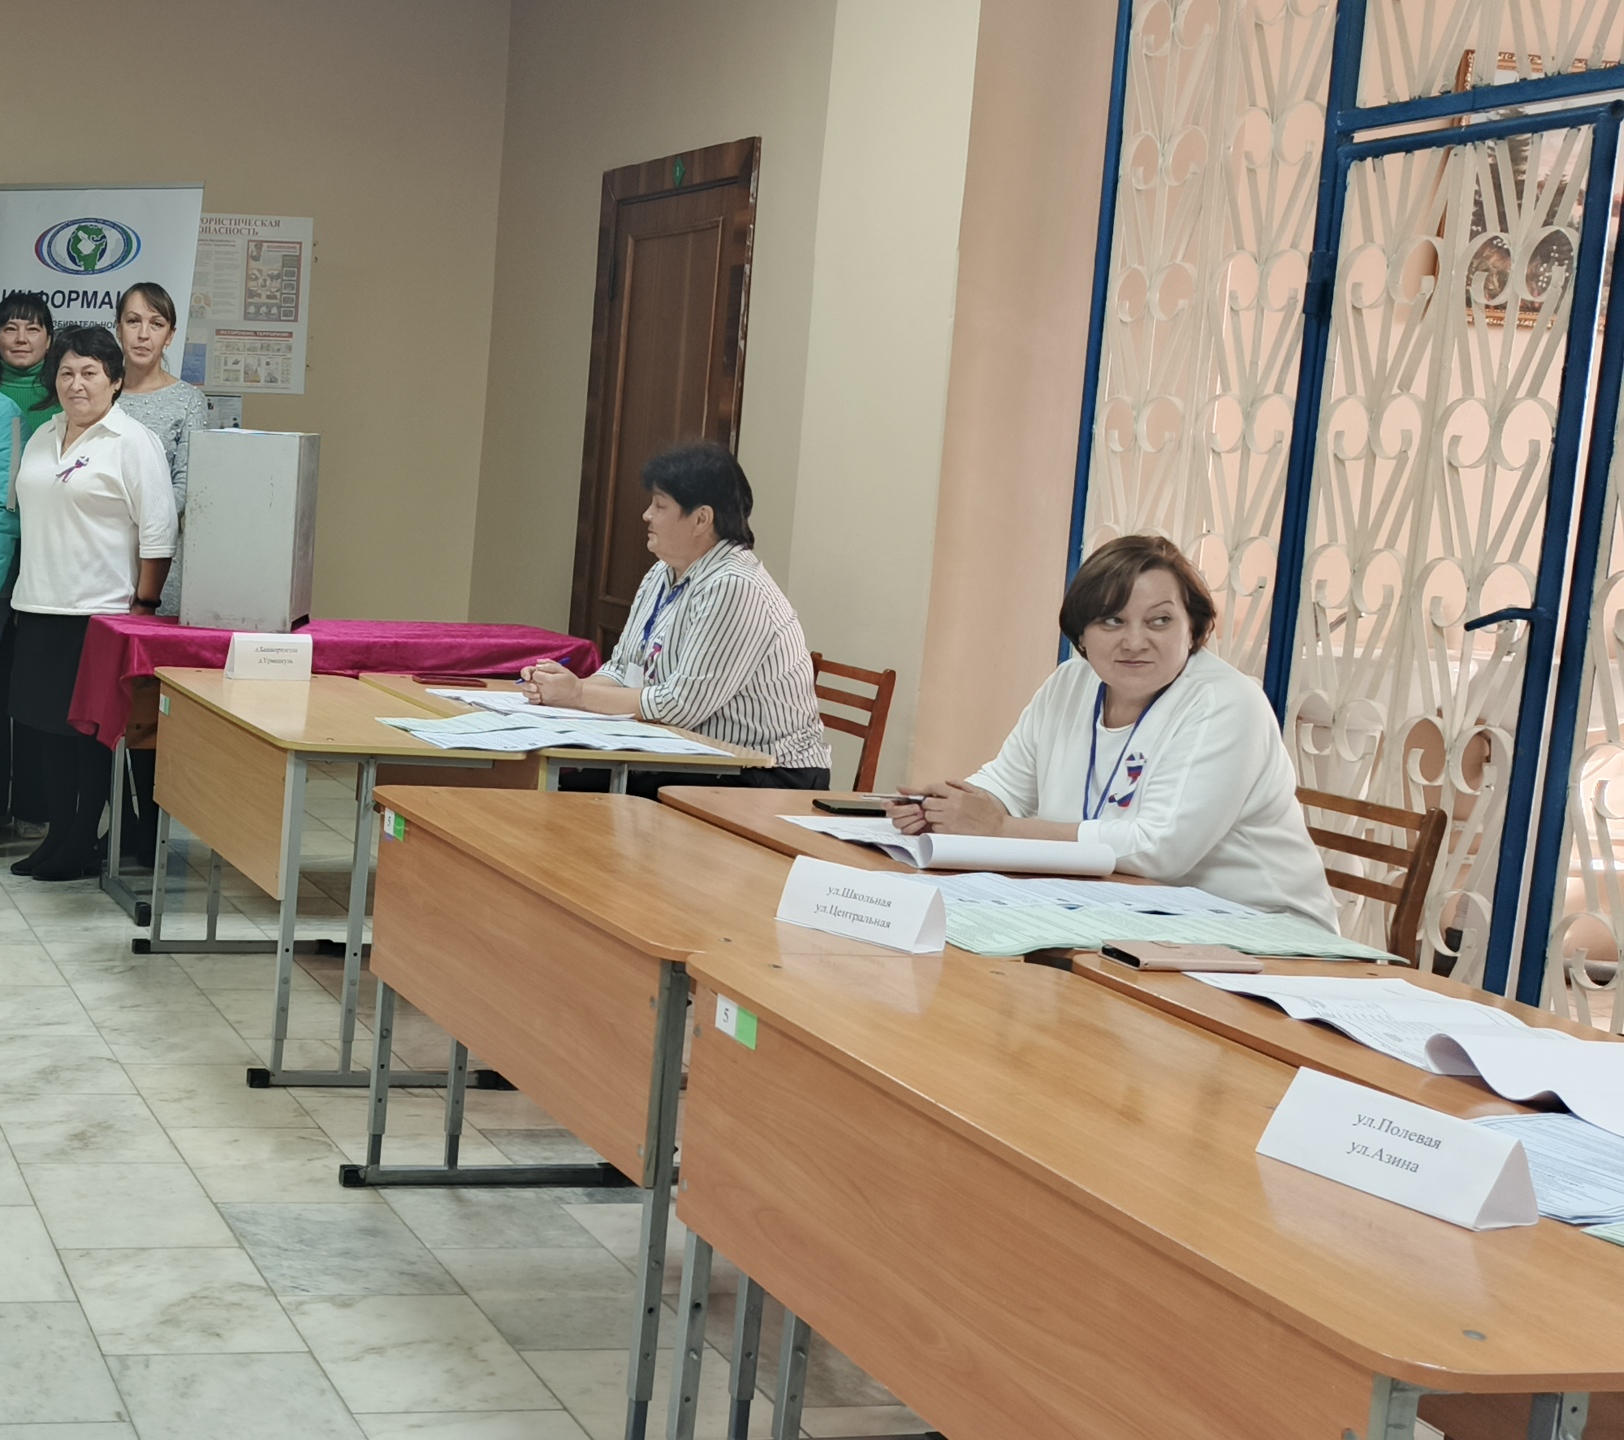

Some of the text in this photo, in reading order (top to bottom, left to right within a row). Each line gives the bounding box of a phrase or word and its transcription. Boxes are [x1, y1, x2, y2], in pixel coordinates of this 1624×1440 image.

[200, 217, 281, 228] ОРИСТИЧЕСКАЯ
[826, 886, 892, 908] ул.Школьная
[813, 902, 892, 929] ул.Центральная
[1352, 1112, 1442, 1150] ул.Полевая
[1346, 1140, 1420, 1173] ул.Азина
